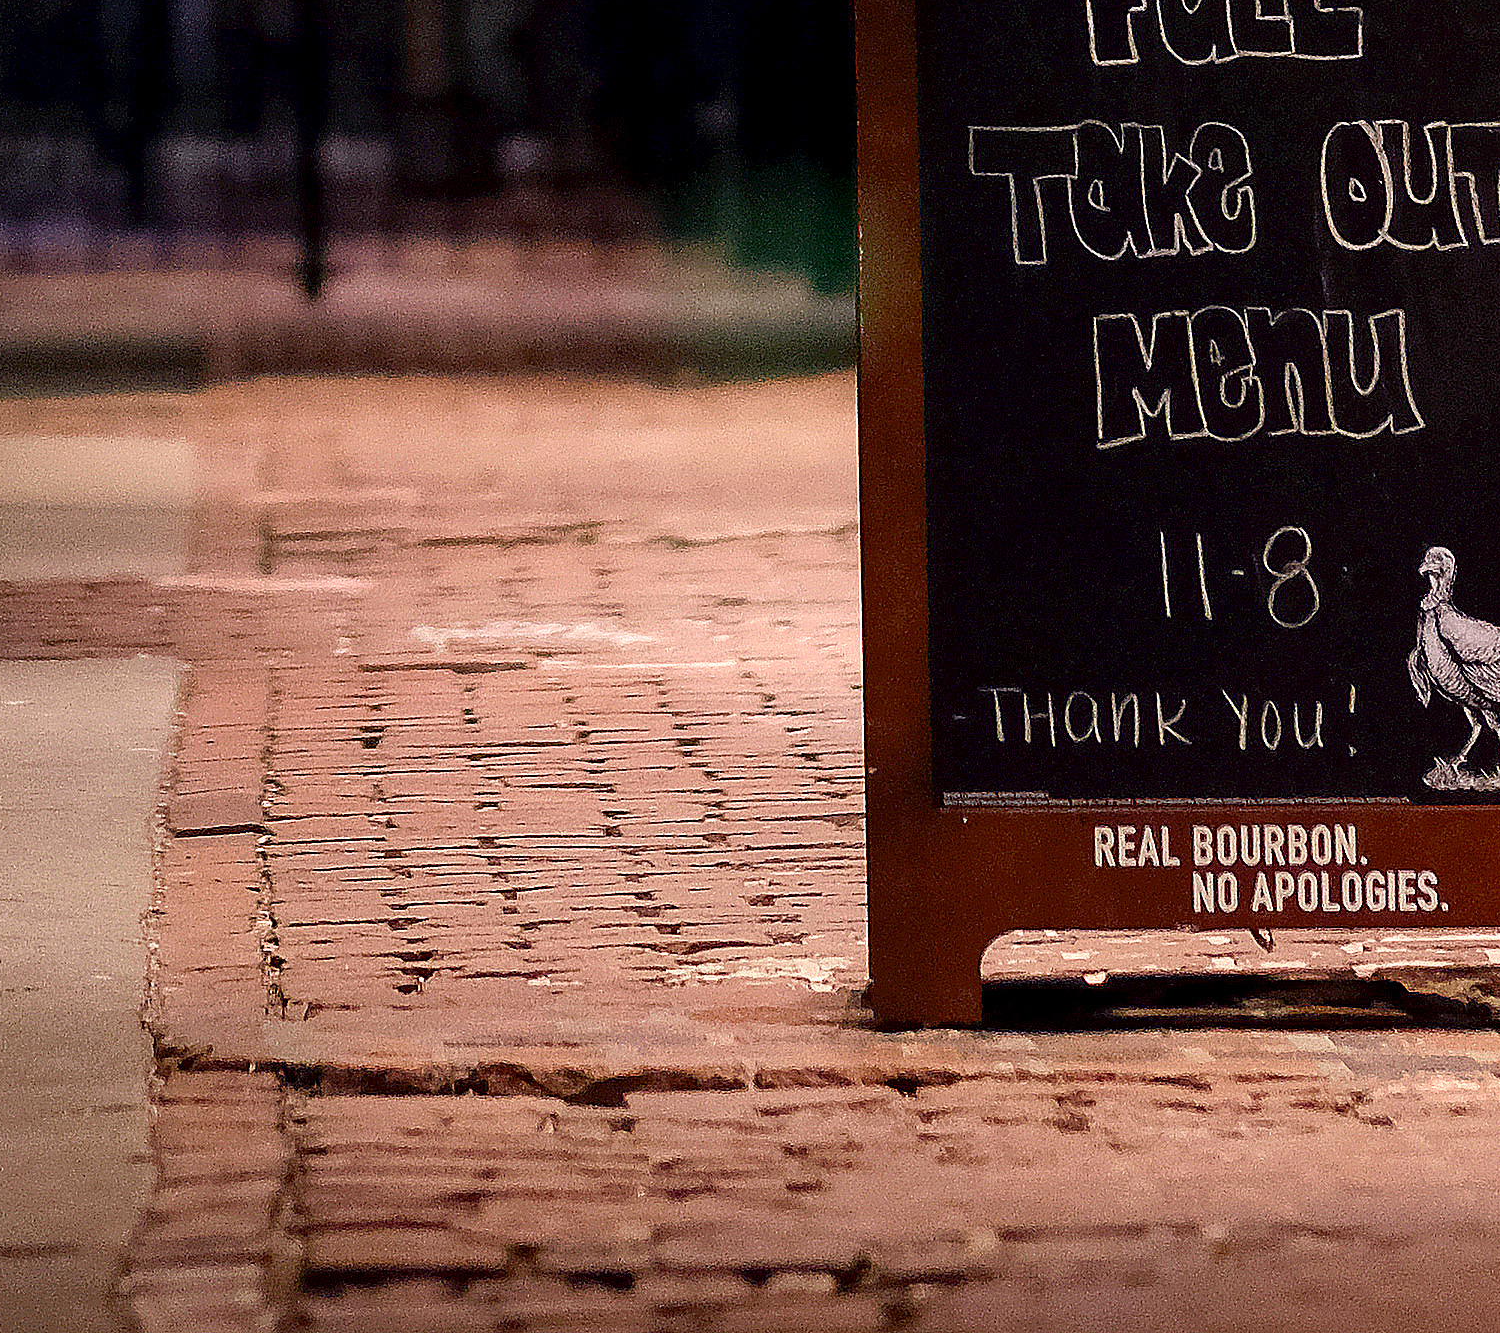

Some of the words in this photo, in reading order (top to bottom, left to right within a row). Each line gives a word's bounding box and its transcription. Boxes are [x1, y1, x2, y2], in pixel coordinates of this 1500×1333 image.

[1159, 526, 1320, 629] 11-8
[1093, 824, 1181, 868] REAL
[1191, 823, 1369, 868] BOURBON.
[1192, 869, 1240, 914] NO
[1251, 869, 1450, 914] APOLOGIES.
